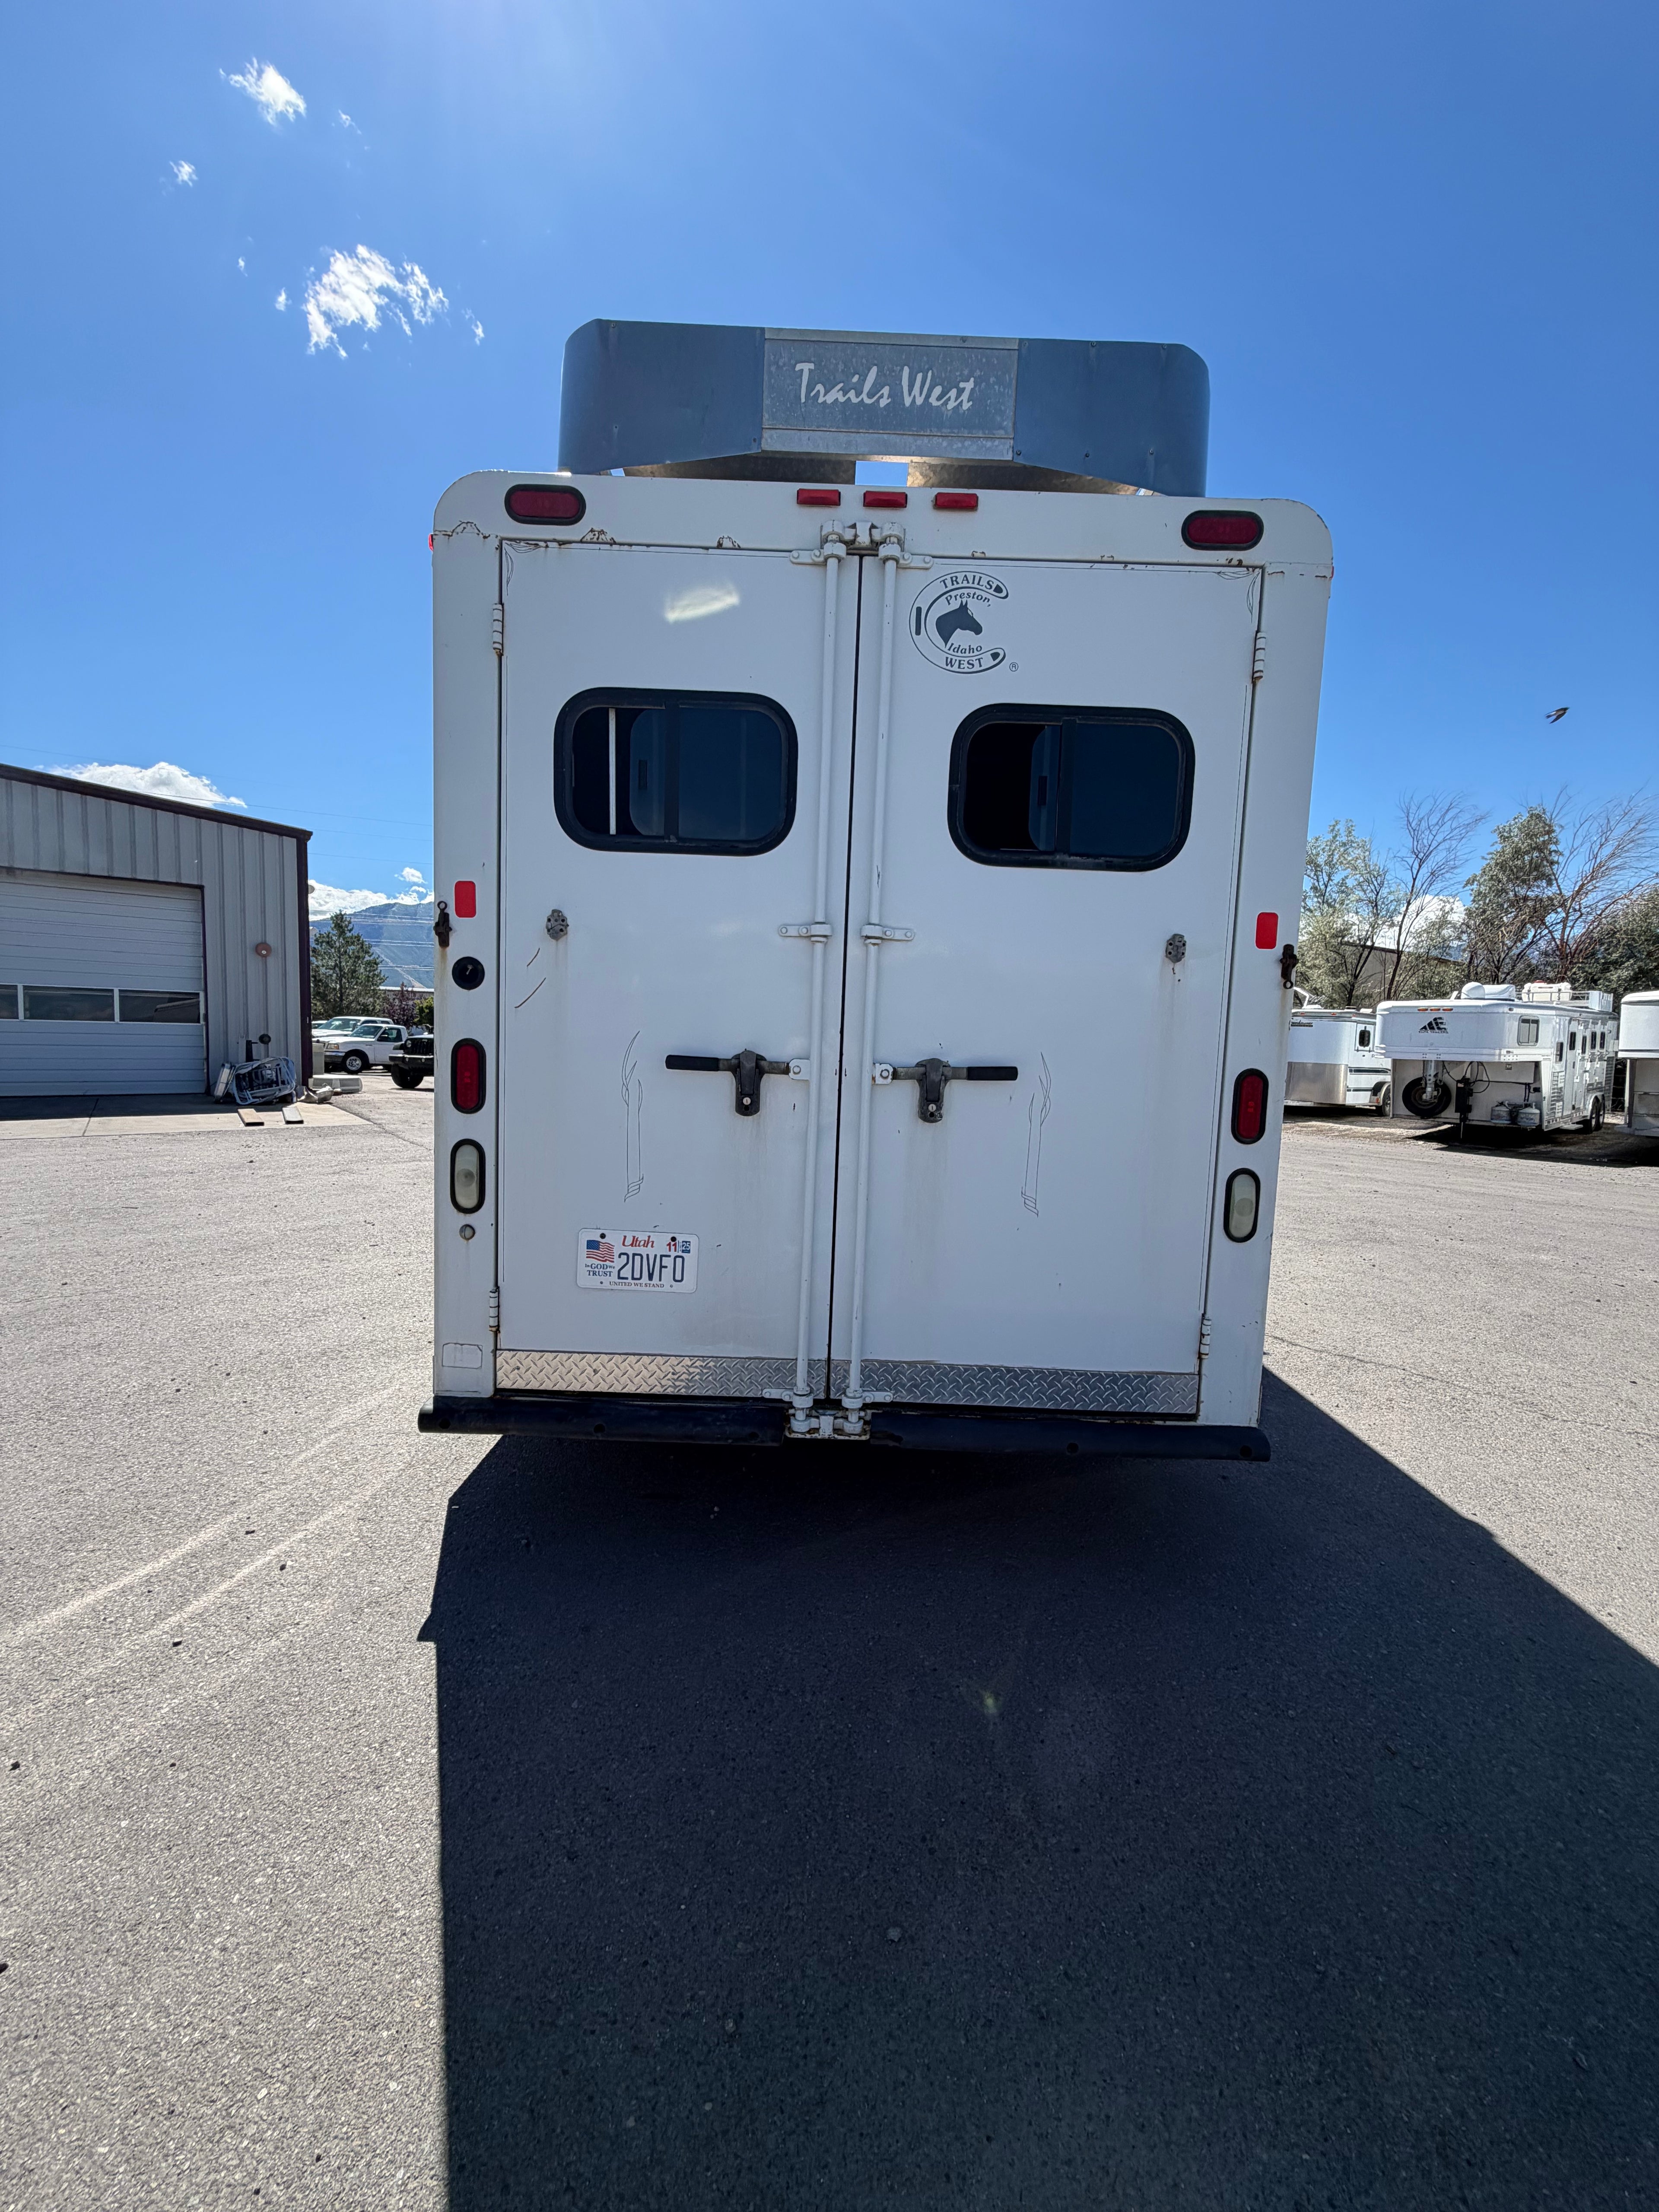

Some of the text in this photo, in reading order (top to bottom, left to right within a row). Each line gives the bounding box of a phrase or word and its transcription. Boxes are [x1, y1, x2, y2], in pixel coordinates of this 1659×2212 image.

[795, 362, 974, 410] Trails West
[940, 574, 994, 590] TRAILS
[947, 642, 982, 654] Idaho
[945, 656, 983, 669] WEST
[622, 1235, 655, 1248] Utah
[666, 1241, 677, 1252] 11
[682, 1242, 690, 1251] 25
